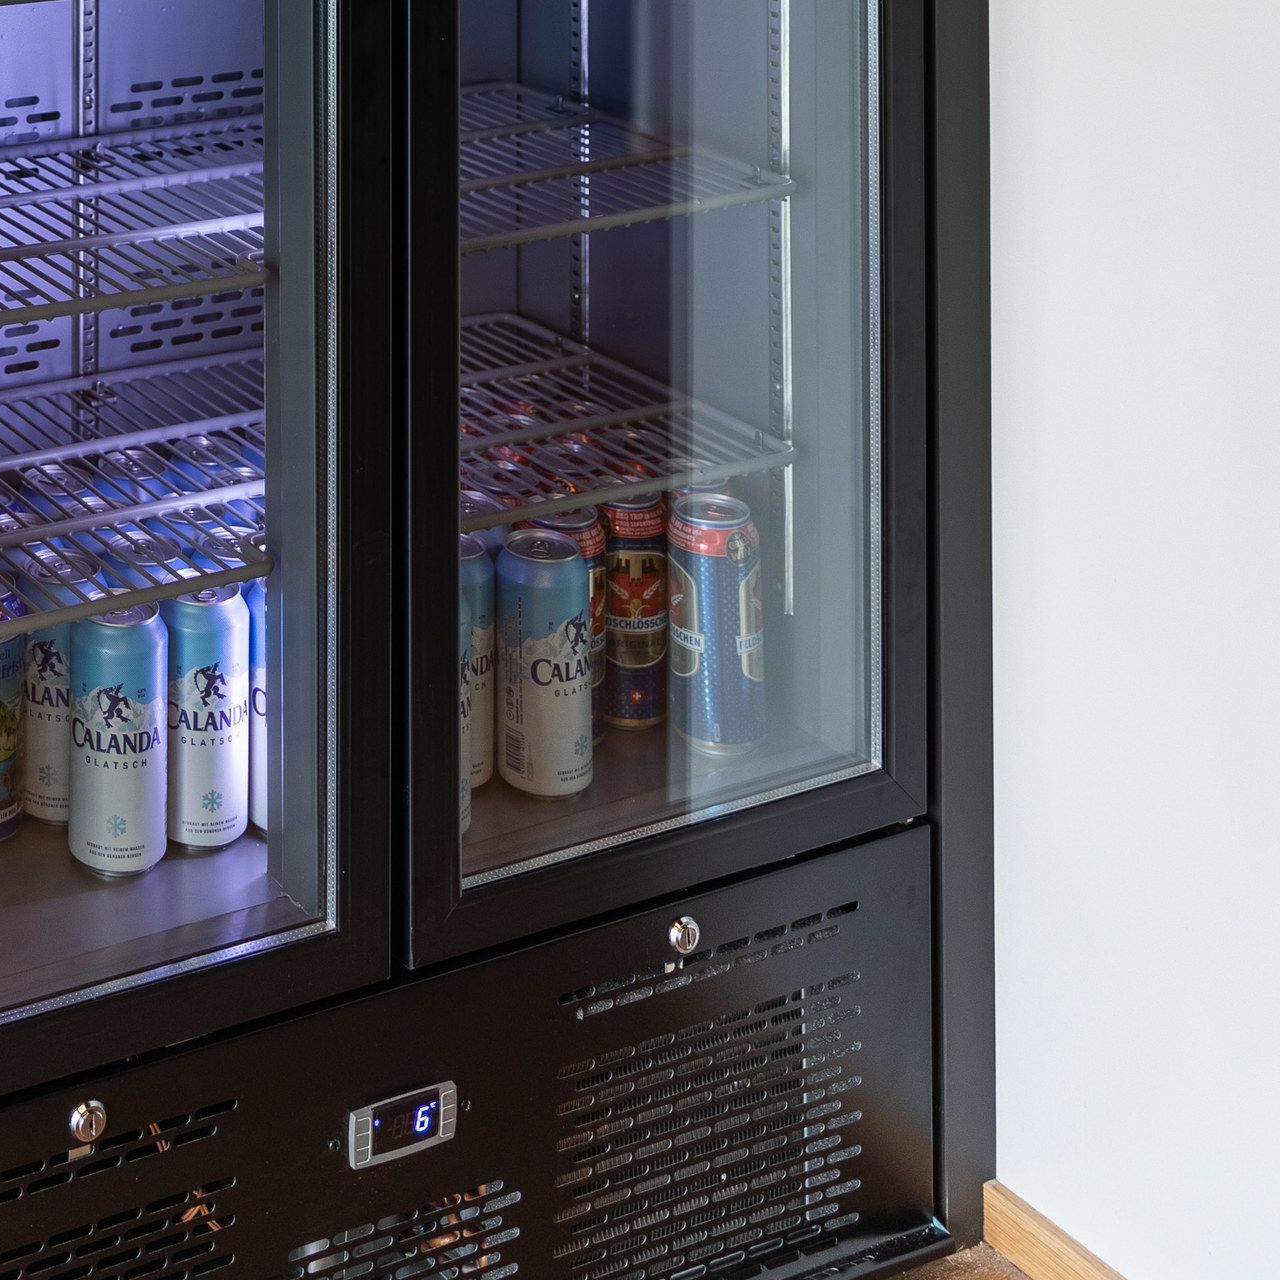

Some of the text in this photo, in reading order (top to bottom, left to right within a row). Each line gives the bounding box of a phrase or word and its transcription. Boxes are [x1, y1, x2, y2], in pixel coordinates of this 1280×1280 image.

[168, 700, 248, 732] CALANDA
[72, 717, 161, 755] CALANDA
[86, 755, 148, 770] GLATSCH
